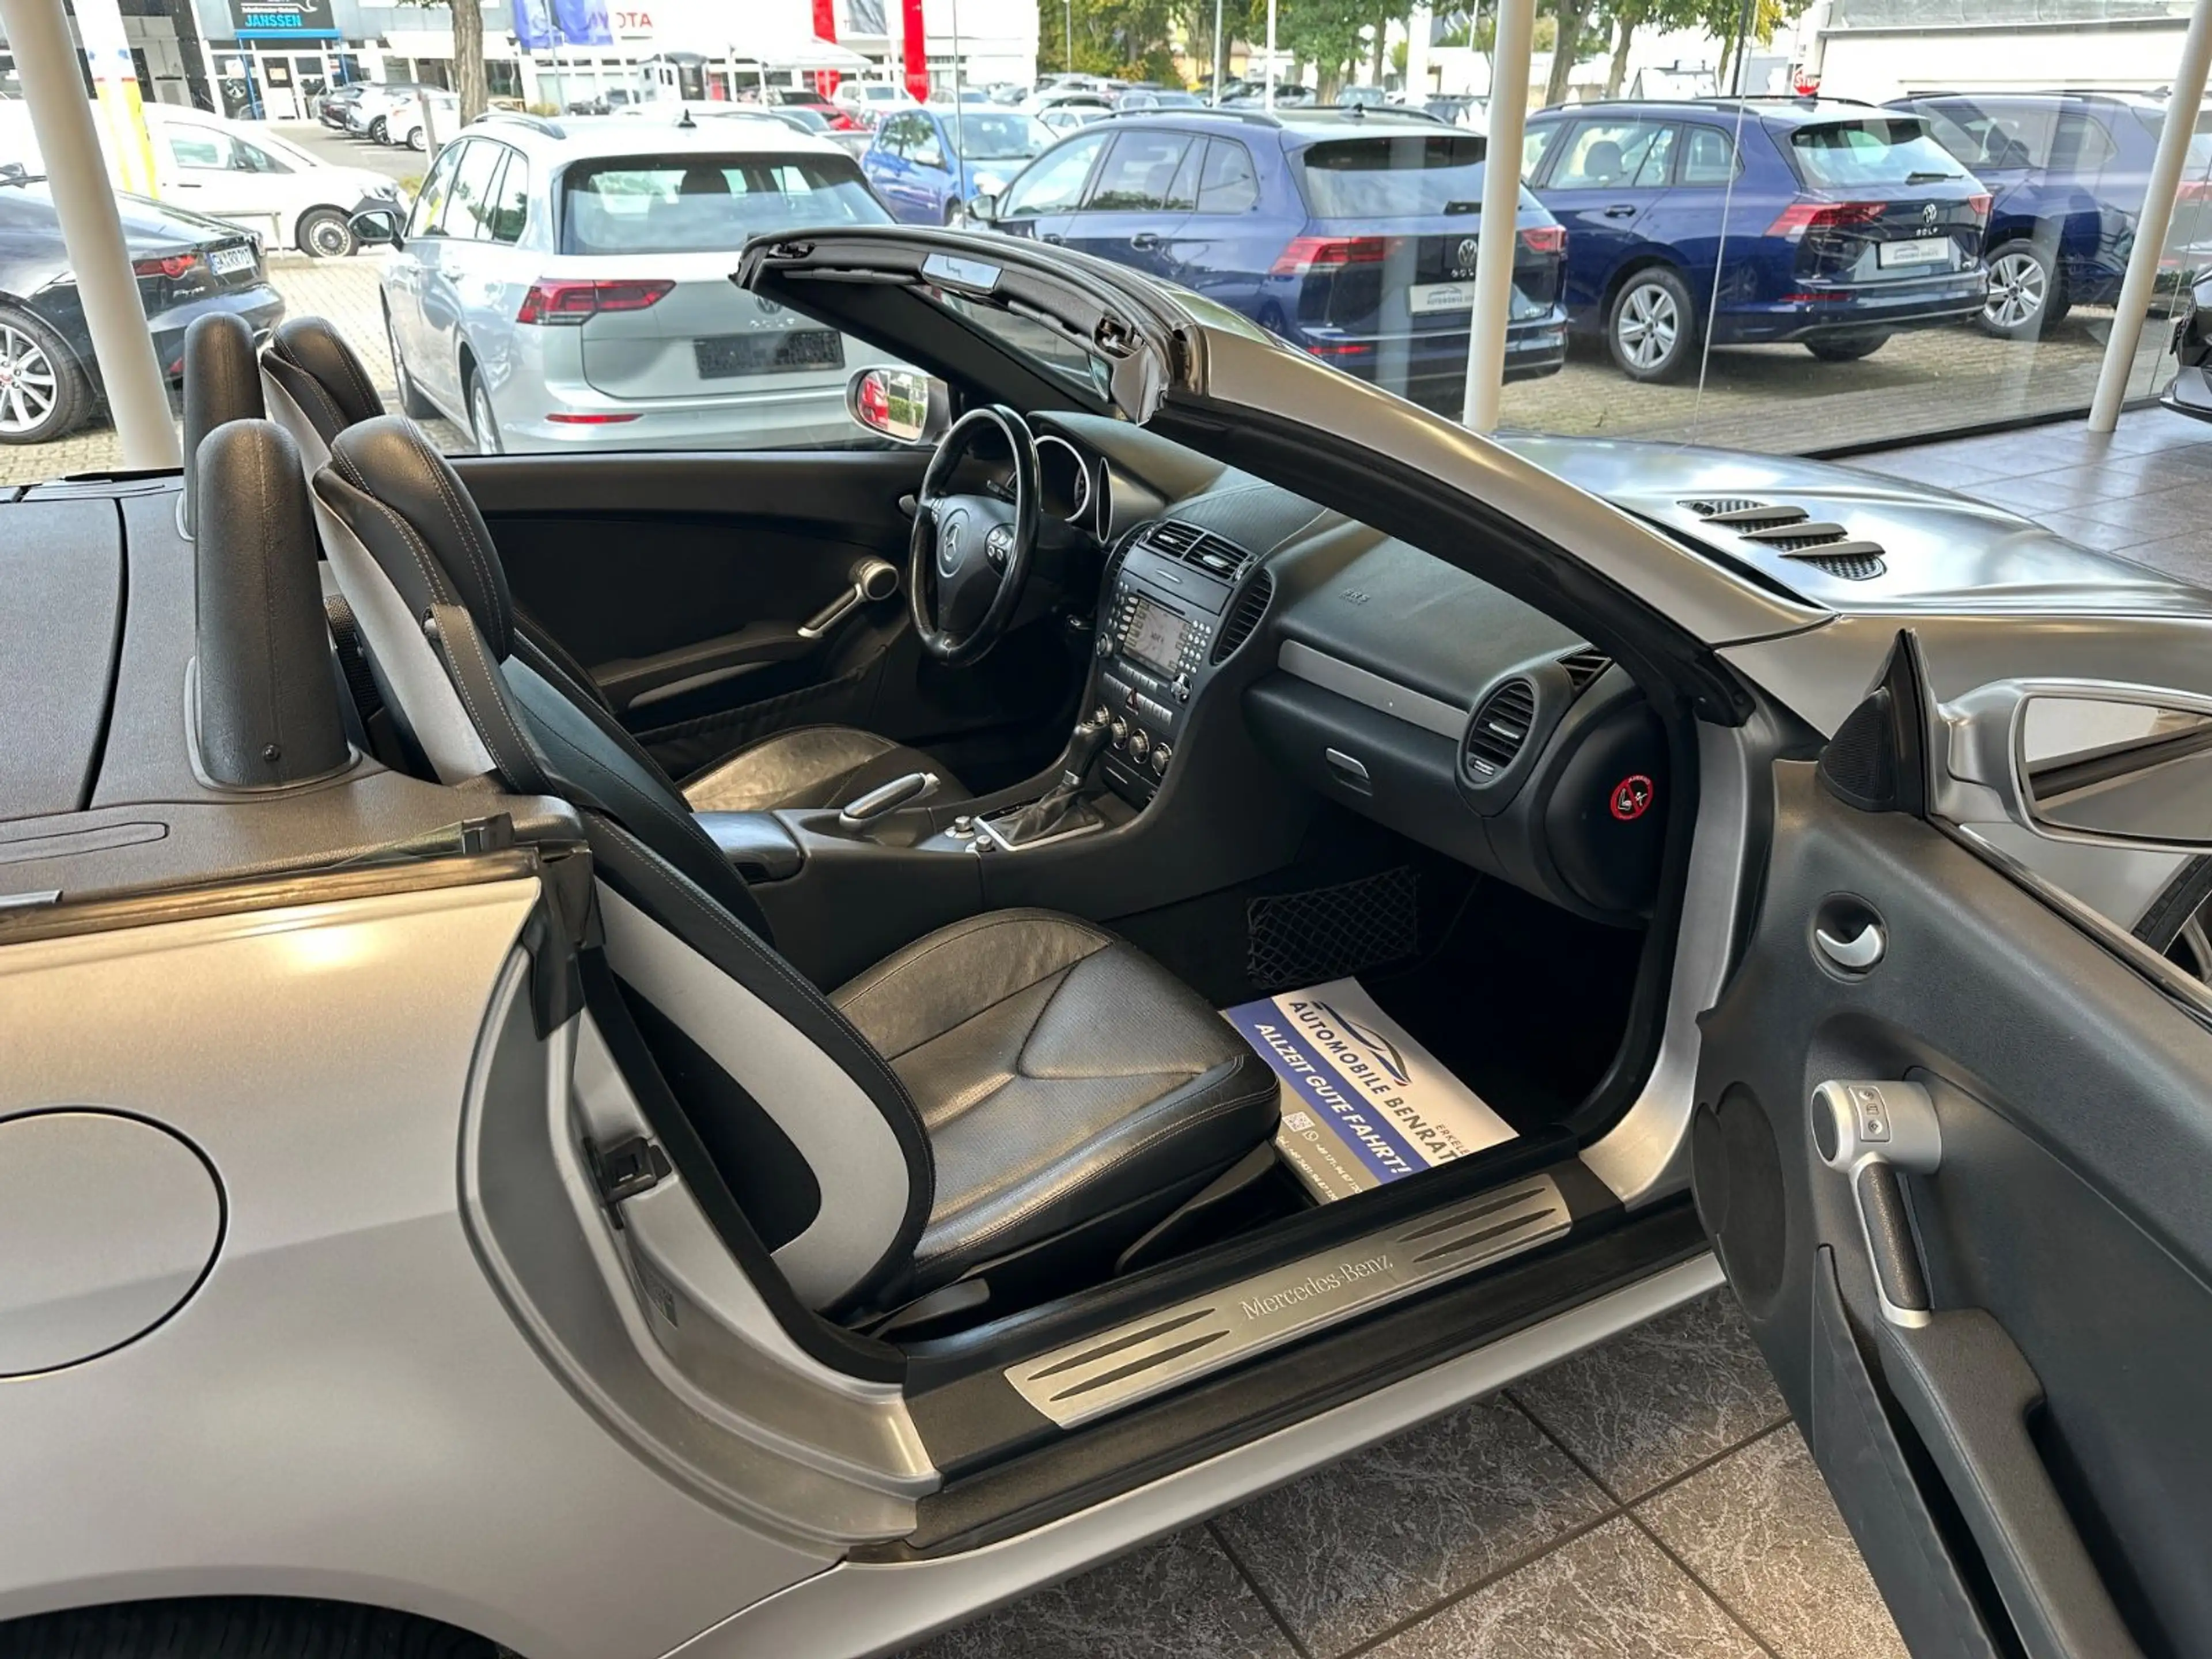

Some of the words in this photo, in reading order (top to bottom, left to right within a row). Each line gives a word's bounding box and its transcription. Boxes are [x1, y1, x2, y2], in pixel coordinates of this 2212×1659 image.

[245, 14, 302, 27] JANSSEN
[1289, 1002, 1391, 1094] AUTOMOBILE
[1253, 1024, 1317, 1073] ALLZEIT
[1306, 1075, 1354, 1113] GUTE
[1342, 1113, 1413, 1173] FAHRT!
[1239, 1255, 1394, 1320] Mercedes-Benz
